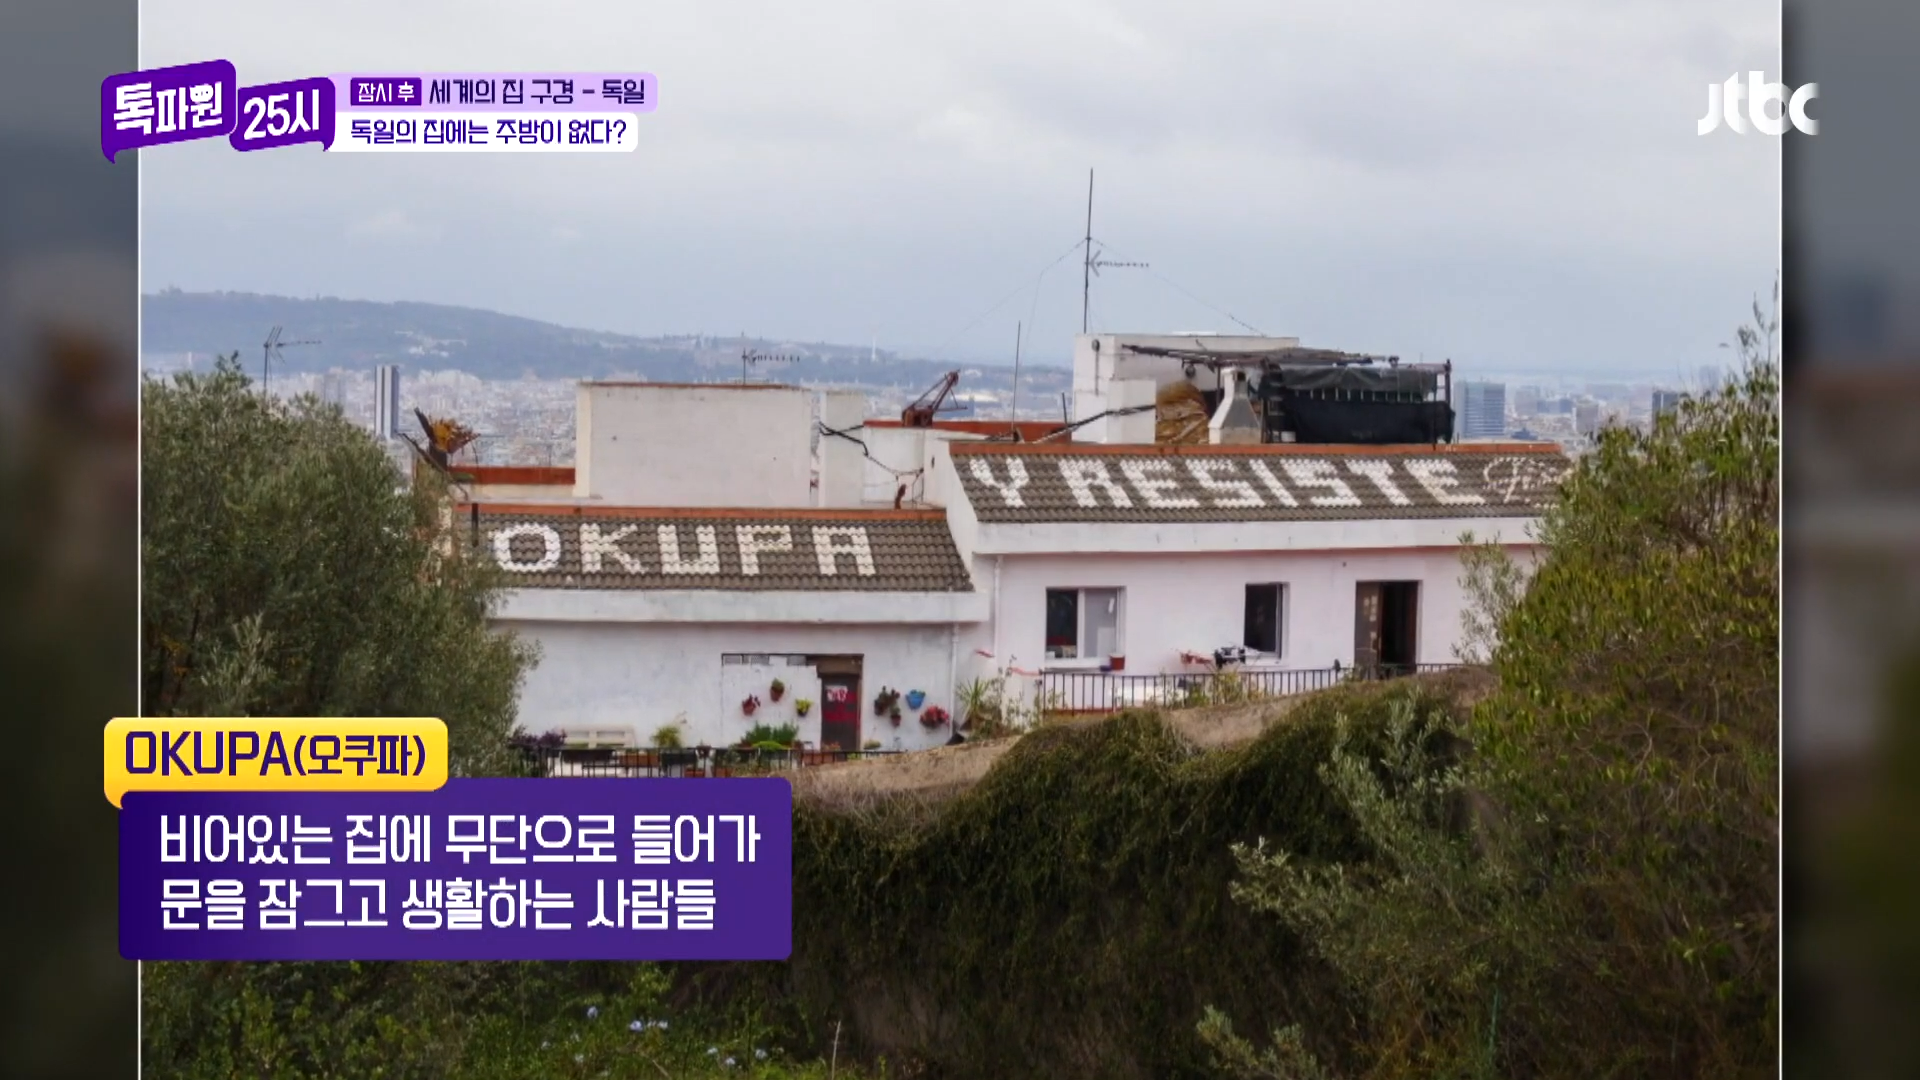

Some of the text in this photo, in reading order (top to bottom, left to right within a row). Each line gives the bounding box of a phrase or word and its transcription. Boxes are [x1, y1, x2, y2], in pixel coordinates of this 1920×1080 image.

[969, 457, 1486, 508] Y RESISTE
[493, 522, 878, 576] OKUPA
